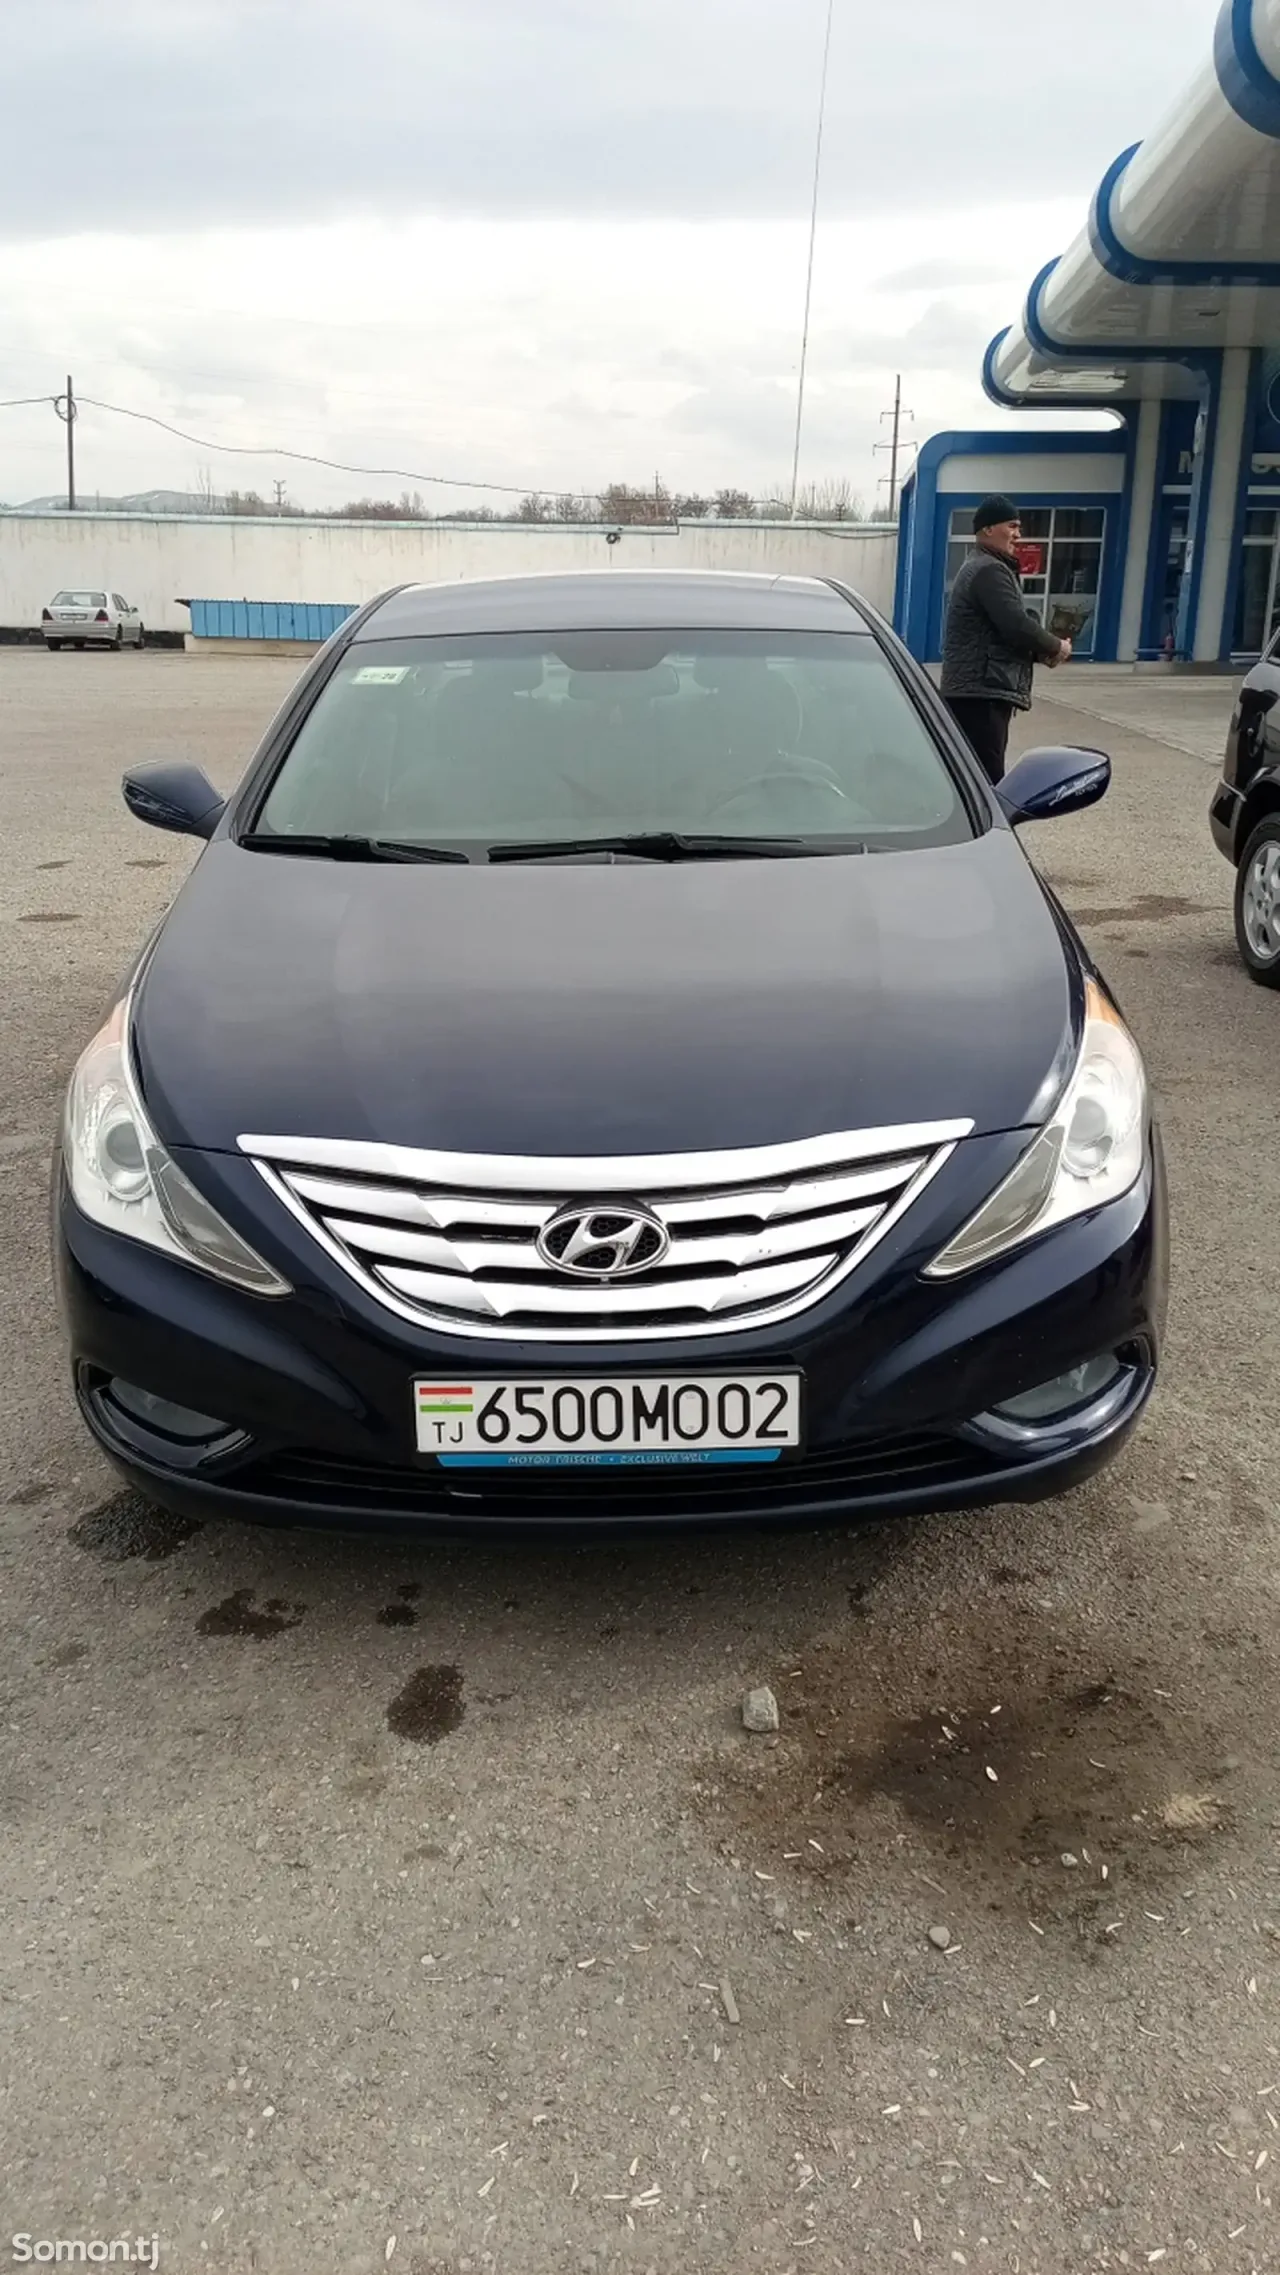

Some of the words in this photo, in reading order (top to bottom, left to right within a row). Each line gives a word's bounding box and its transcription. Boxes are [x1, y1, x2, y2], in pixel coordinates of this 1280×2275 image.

[476, 1382, 789, 1444] 6500MO02
[431, 1421, 463, 1444] TJ
[507, 1455, 551, 1465] MOTOR
